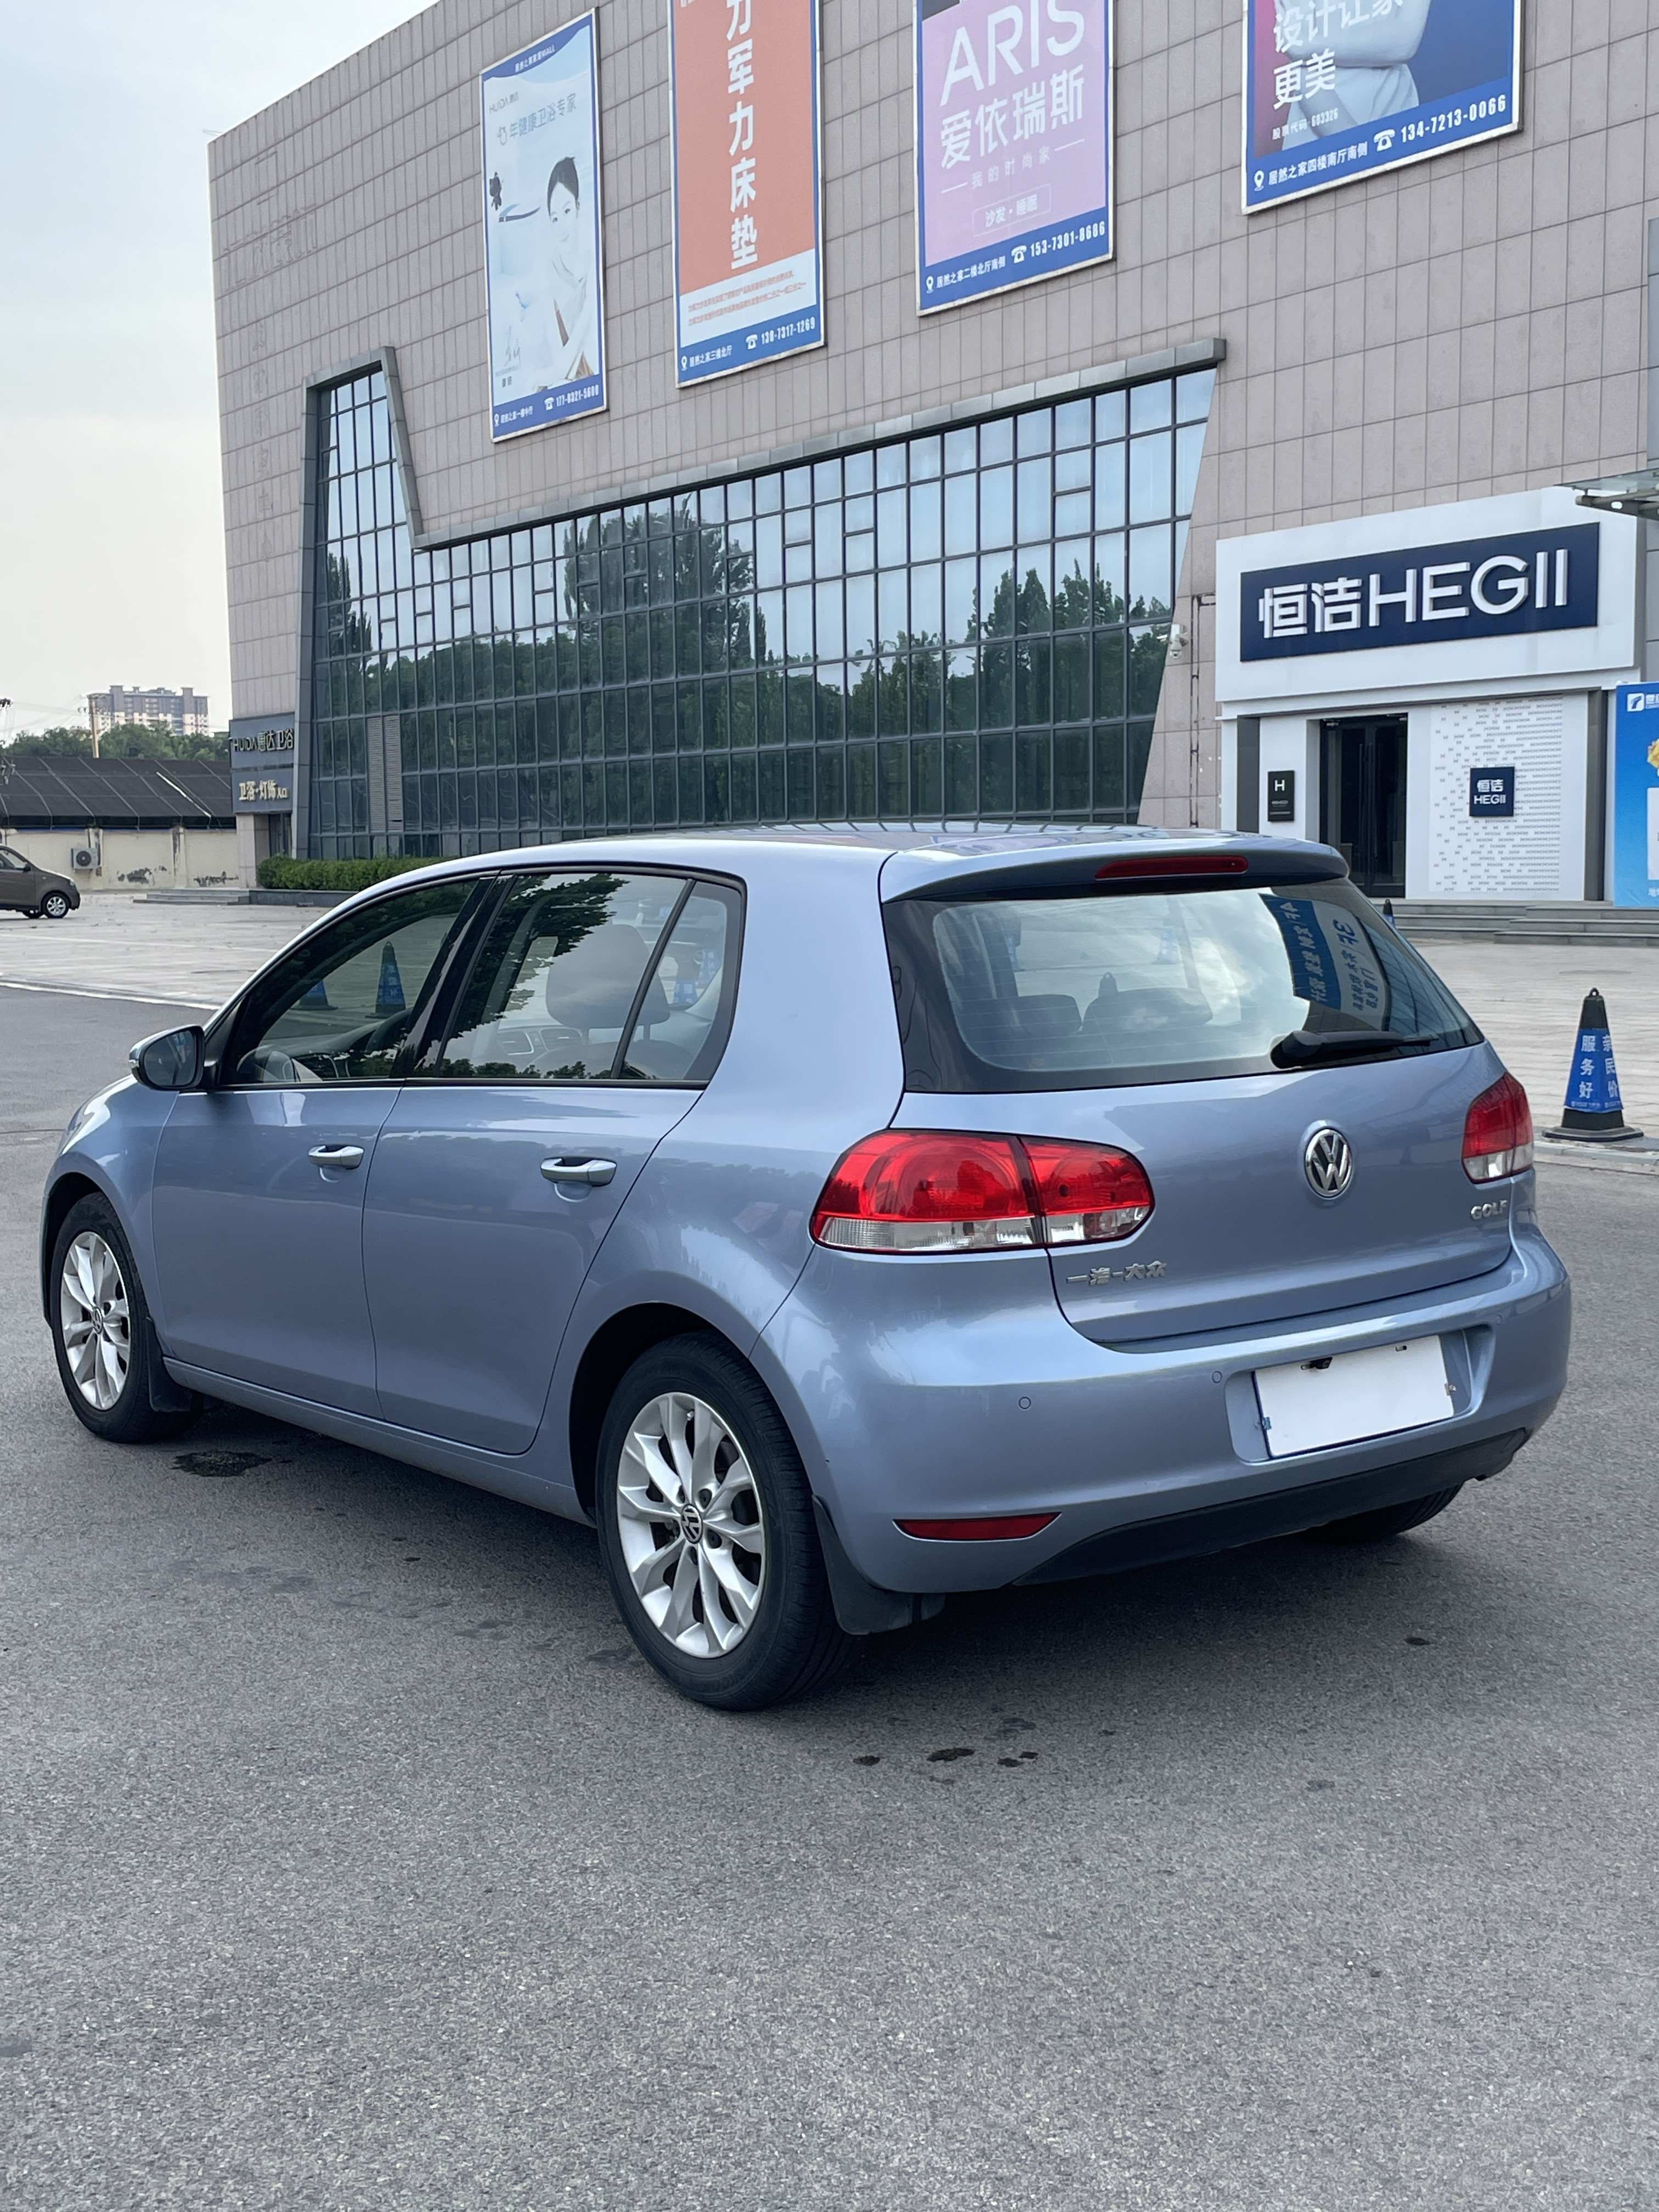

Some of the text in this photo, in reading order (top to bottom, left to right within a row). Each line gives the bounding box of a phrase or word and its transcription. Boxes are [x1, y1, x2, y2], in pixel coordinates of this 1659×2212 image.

[940, 0, 1085, 106] ARIS
[1273, 48, 1336, 110] 更美
[941, 64, 1084, 170] 爱依瑞斯
[1401, 94, 1506, 144] 134-7213-0066
[970, 146, 1049, 189] 我的时尚家
[1268, 142, 1368, 185] 居然之家四楼南厅南侧
[1030, 221, 1105, 257] 153-7301-8686
[1274, 780, 1285, 791] H
[1474, 794, 1506, 804] HEGII
[1477, 779, 1504, 792] 恒洁
[1470, 1200, 1508, 1220] GOLF
[1066, 1260, 1167, 1286] 一汽-大众
